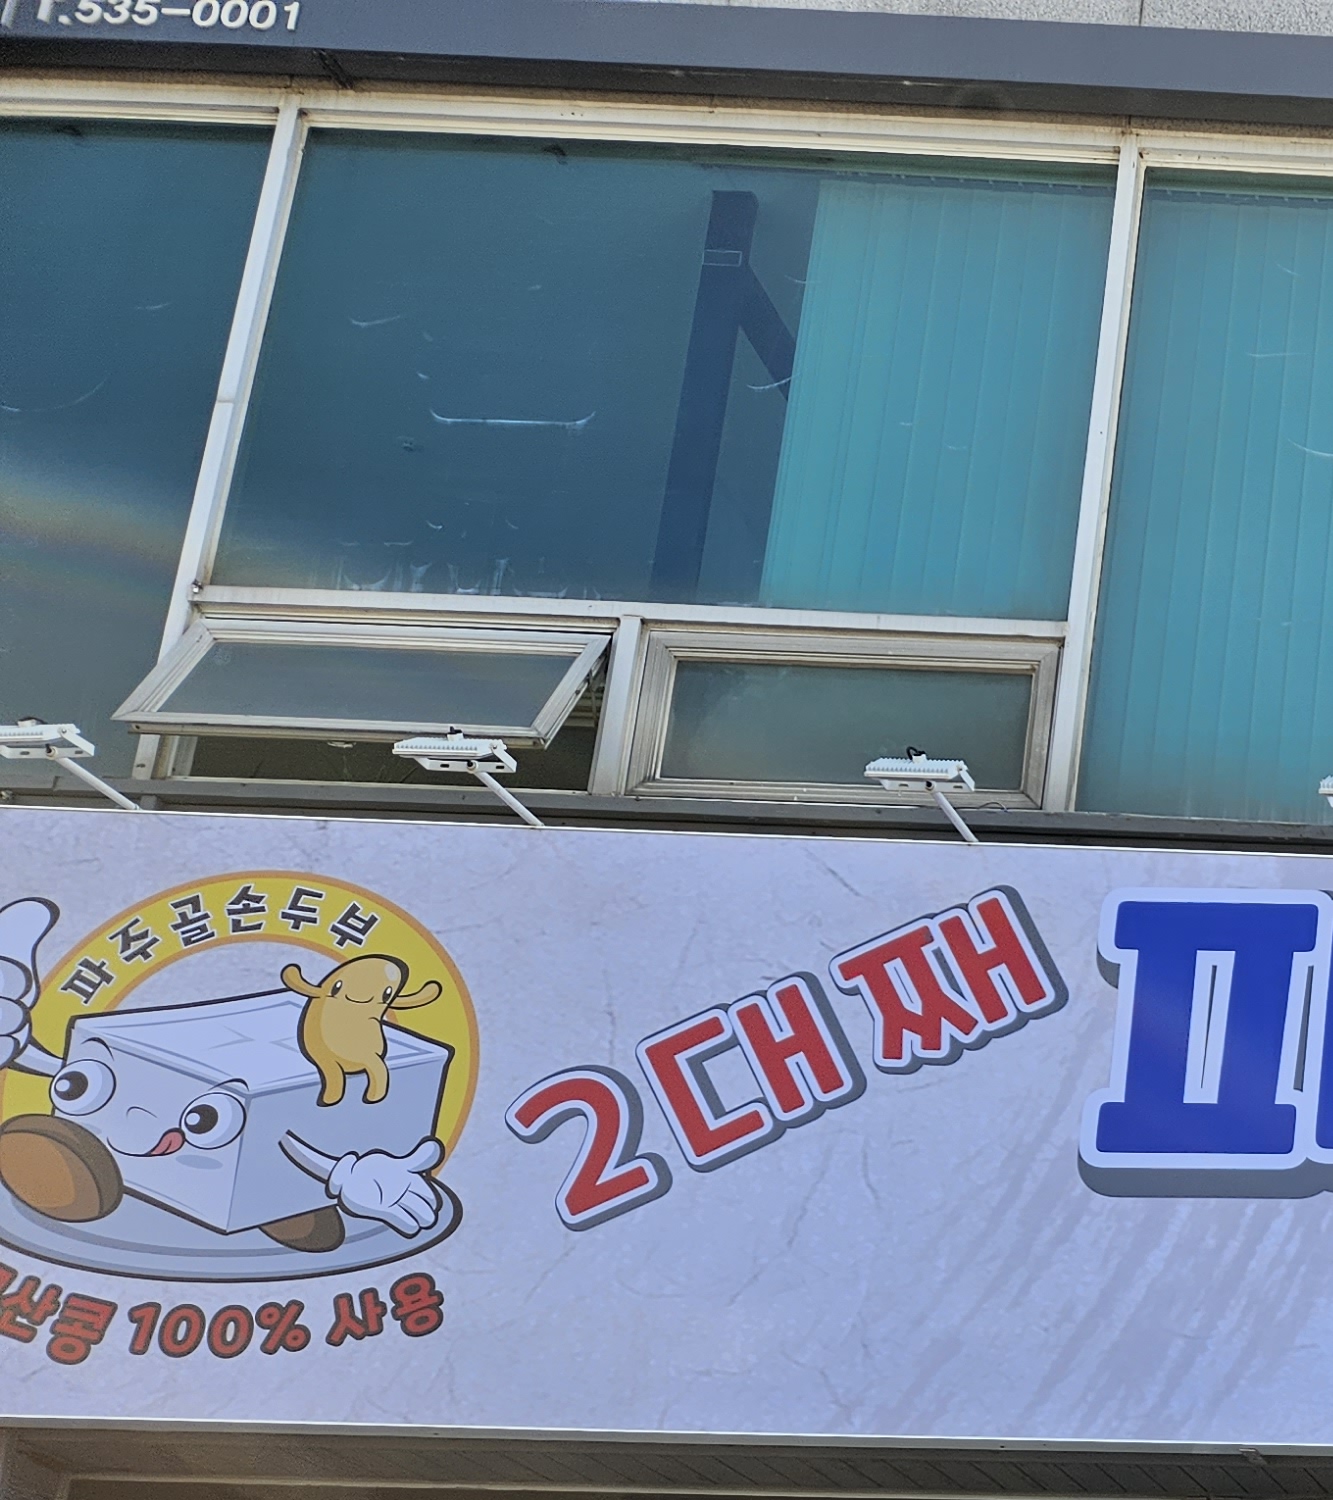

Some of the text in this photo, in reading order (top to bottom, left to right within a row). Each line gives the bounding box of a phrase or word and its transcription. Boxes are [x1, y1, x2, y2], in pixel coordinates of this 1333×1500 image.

[0, 1262, 444, 1365] 산콩 100% 사용
